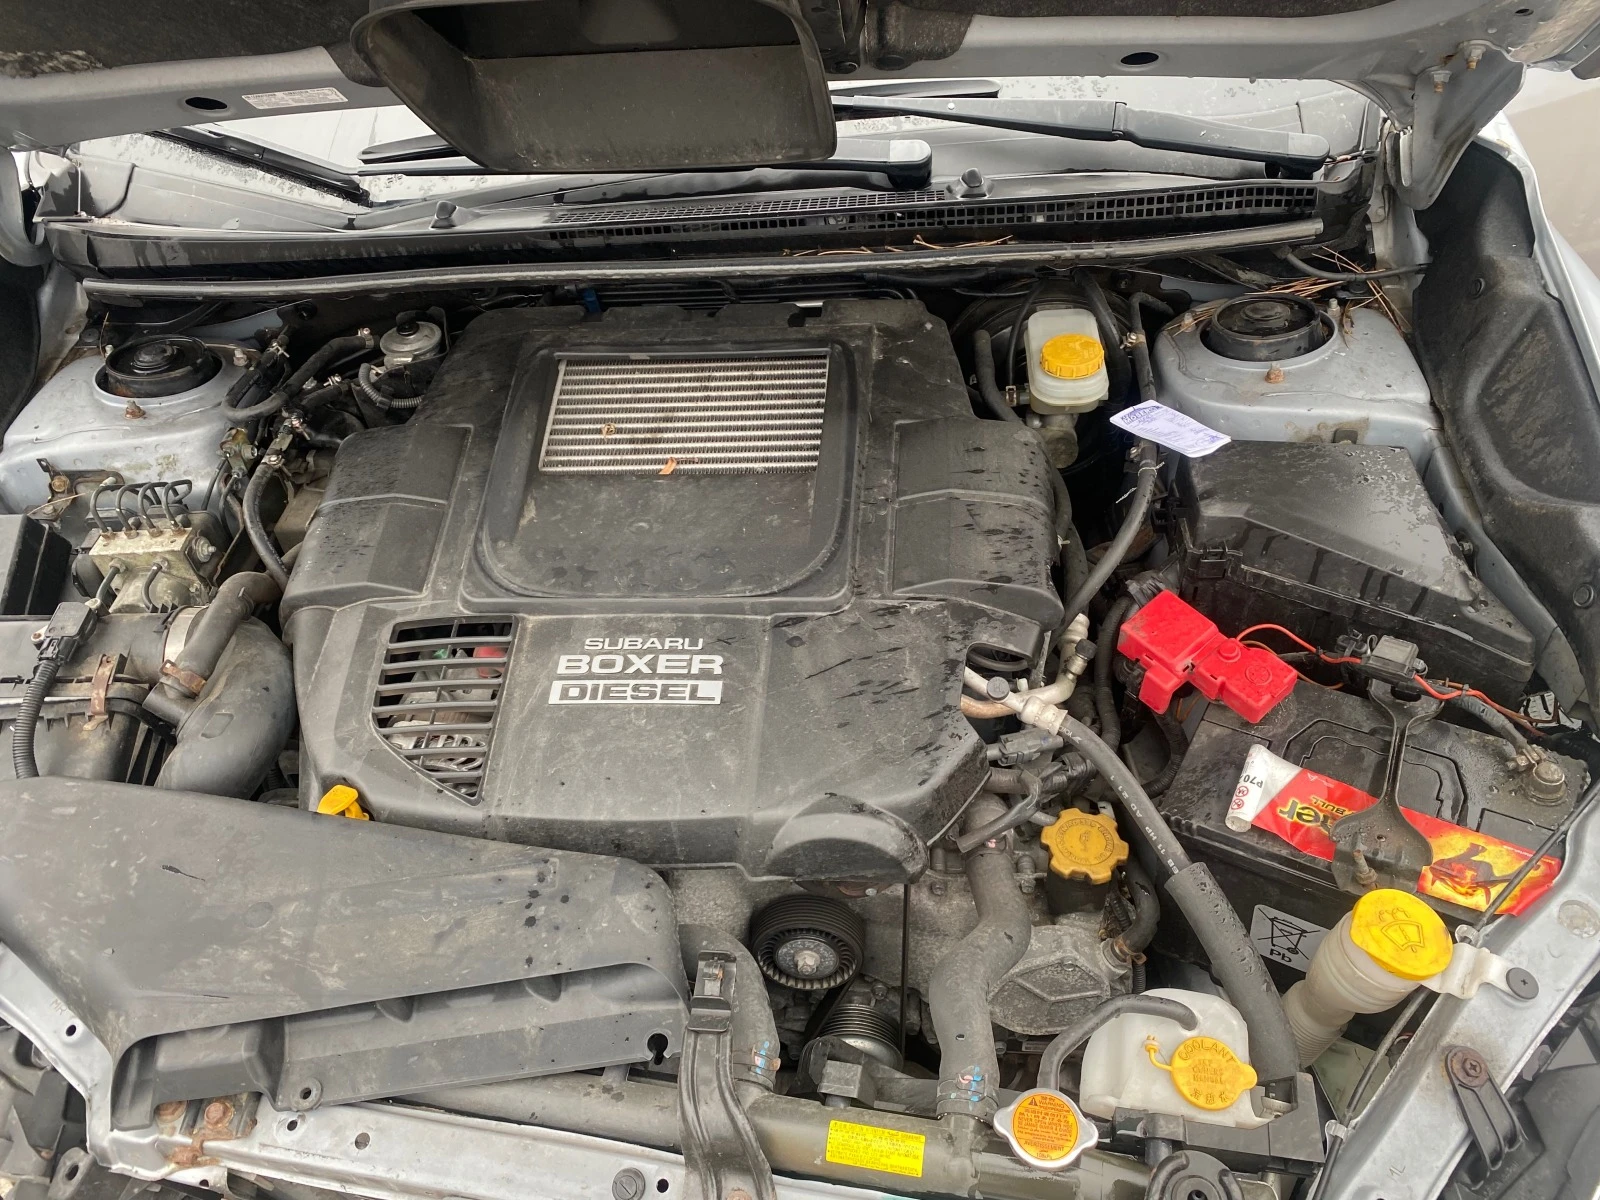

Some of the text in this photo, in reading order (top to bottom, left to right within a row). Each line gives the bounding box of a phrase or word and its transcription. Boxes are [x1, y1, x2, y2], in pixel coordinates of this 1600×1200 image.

[584, 637, 704, 650] SUBARU
[556, 654, 724, 675] BOXER
[558, 683, 717, 701] DIESEL
[1269, 948, 1292, 963] Pb
[1178, 1039, 1238, 1063] COOLANT
